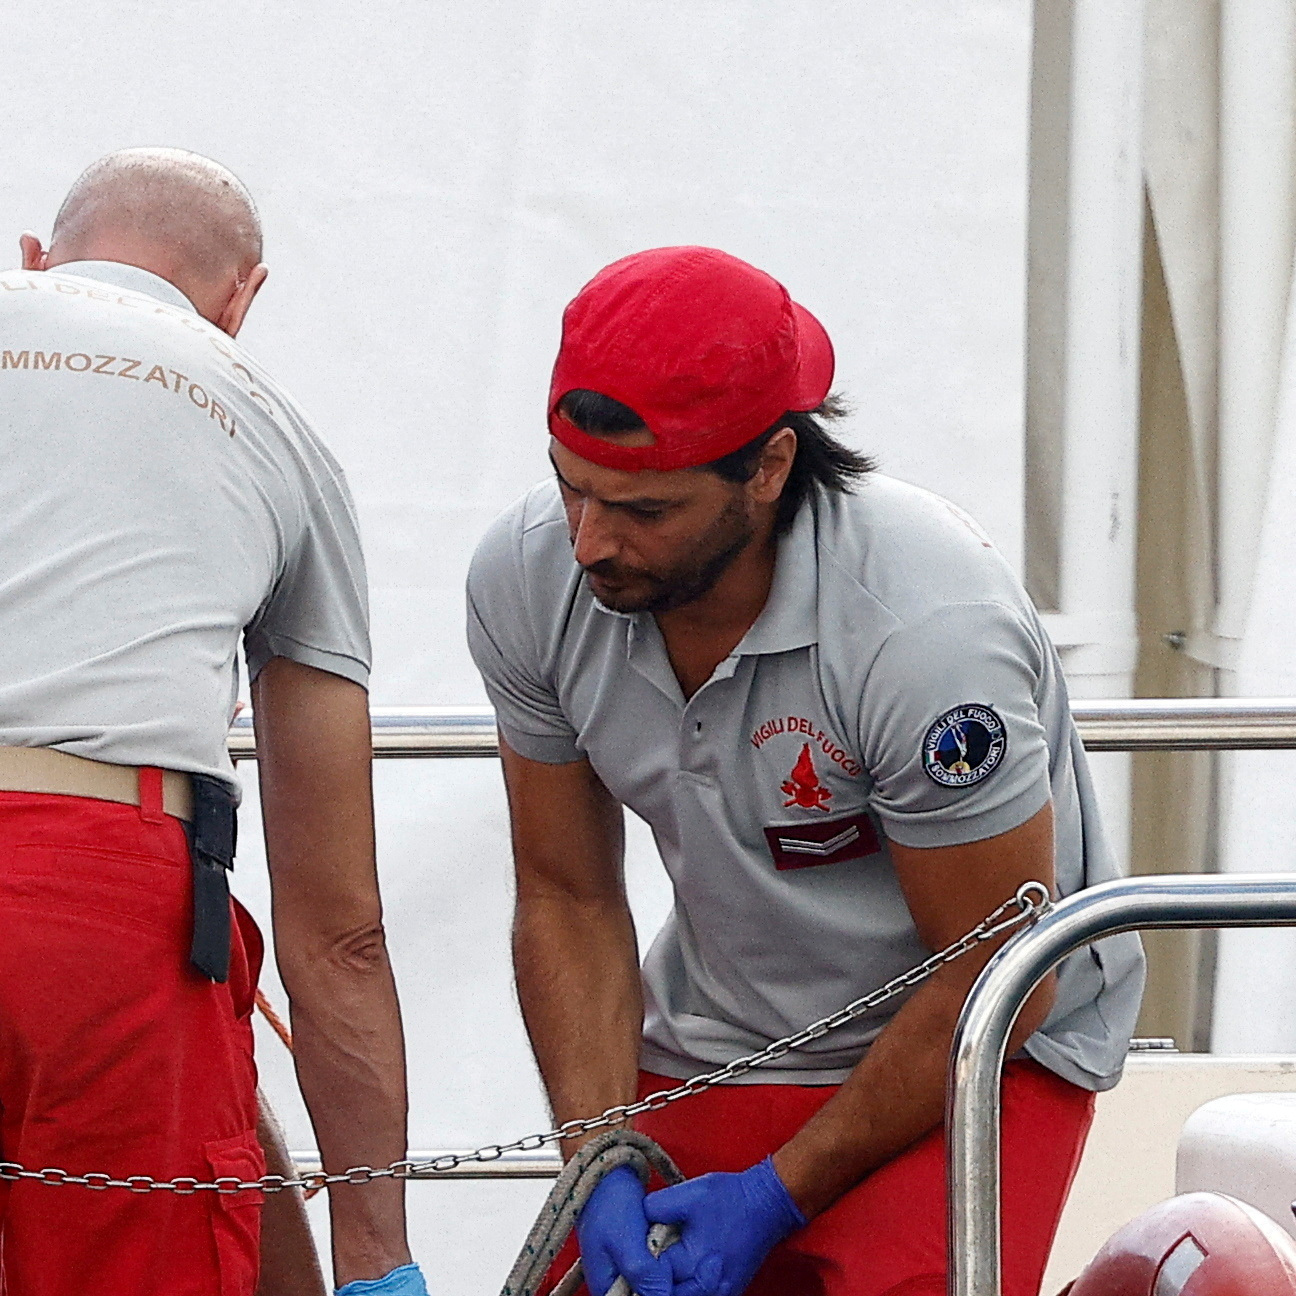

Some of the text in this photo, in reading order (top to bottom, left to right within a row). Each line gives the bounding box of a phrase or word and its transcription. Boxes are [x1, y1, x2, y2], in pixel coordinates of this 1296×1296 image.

[54, 283, 139, 308] DEL
[749, 716, 863, 777] VIGILI DEL FUOCO
[927, 708, 997, 750] VIGILI DEL FUOCO
[930, 746, 1001, 784] SOMMOZZATORI
